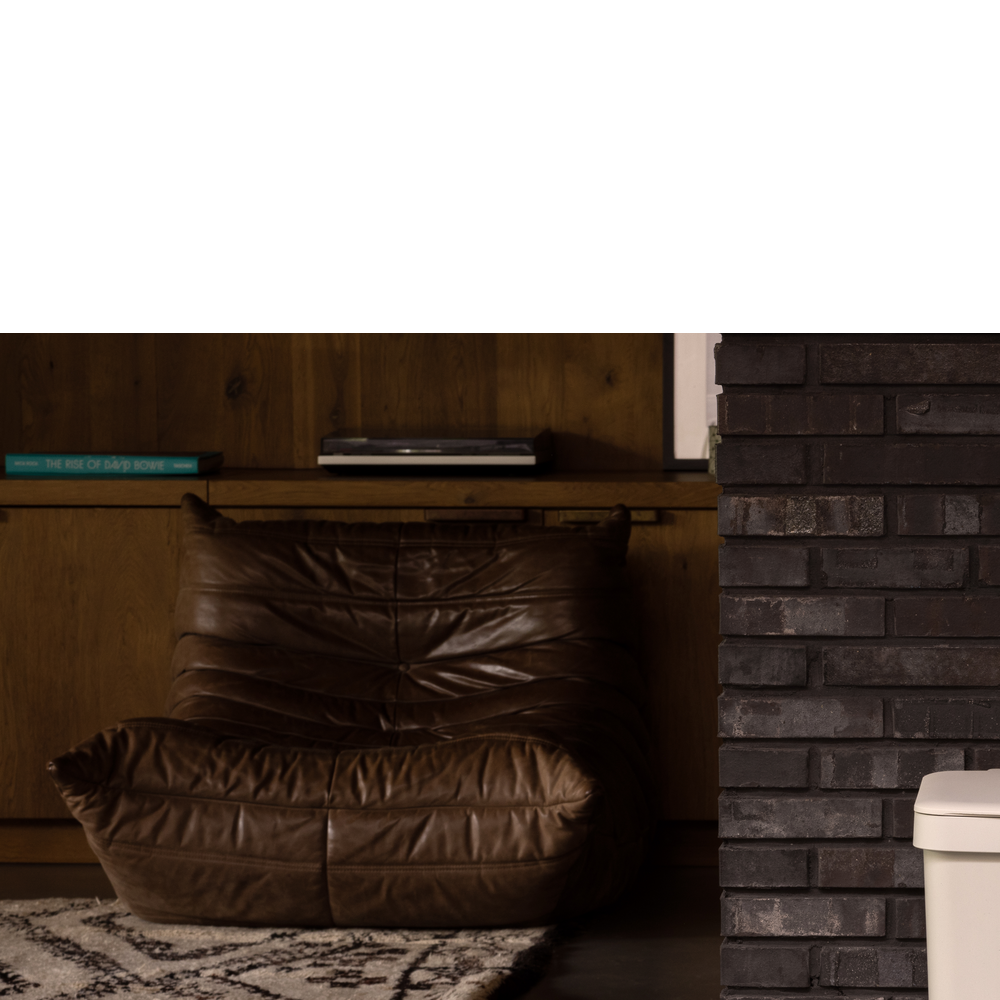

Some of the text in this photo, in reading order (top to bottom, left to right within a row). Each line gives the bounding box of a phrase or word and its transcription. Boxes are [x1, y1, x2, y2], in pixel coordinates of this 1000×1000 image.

[46, 458, 165, 472] THE RISE OF DAVID BOWIE
